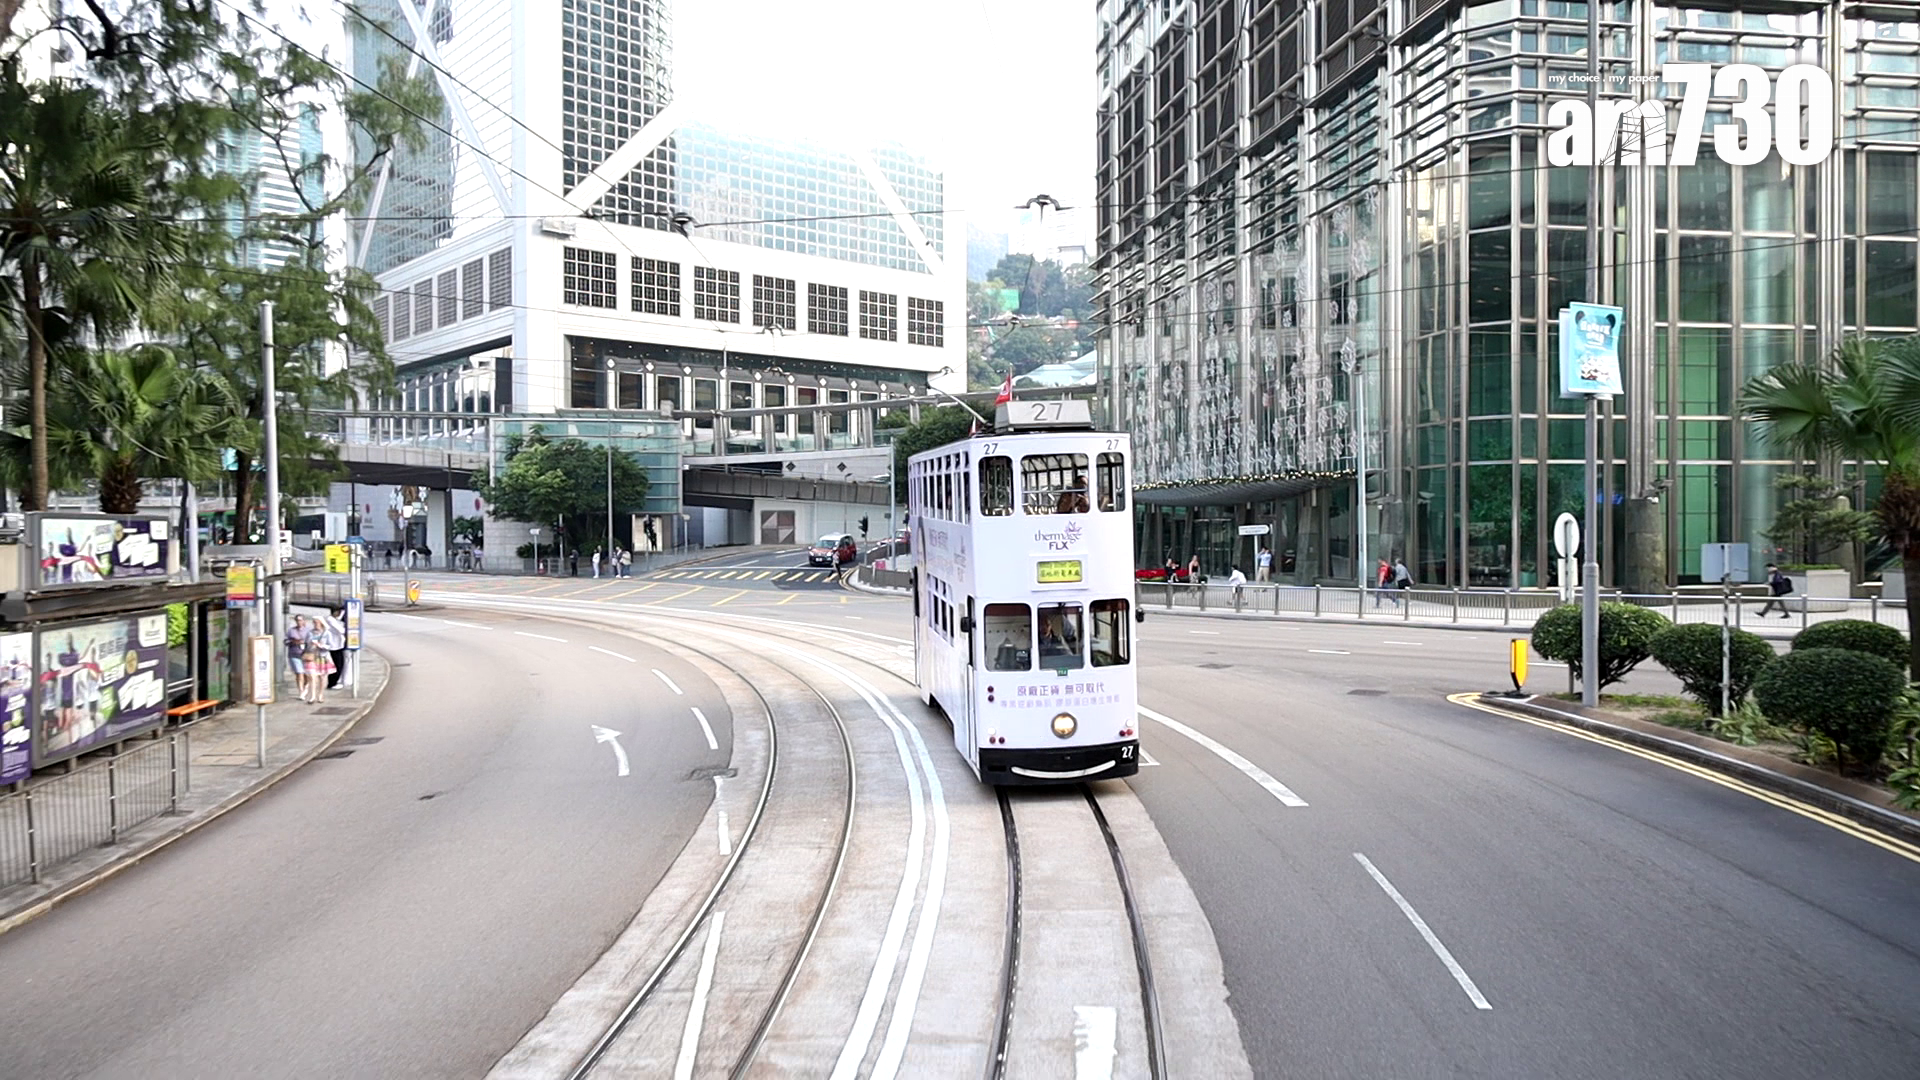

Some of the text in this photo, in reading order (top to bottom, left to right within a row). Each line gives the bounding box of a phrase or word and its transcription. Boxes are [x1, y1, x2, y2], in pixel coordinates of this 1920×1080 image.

[1031, 402, 1063, 421] 27
[984, 442, 999, 455] 27
[1106, 439, 1119, 450] 27
[1034, 529, 1082, 544] thermage
[1049, 541, 1069, 550] FLX
[1121, 745, 1134, 759] 27
